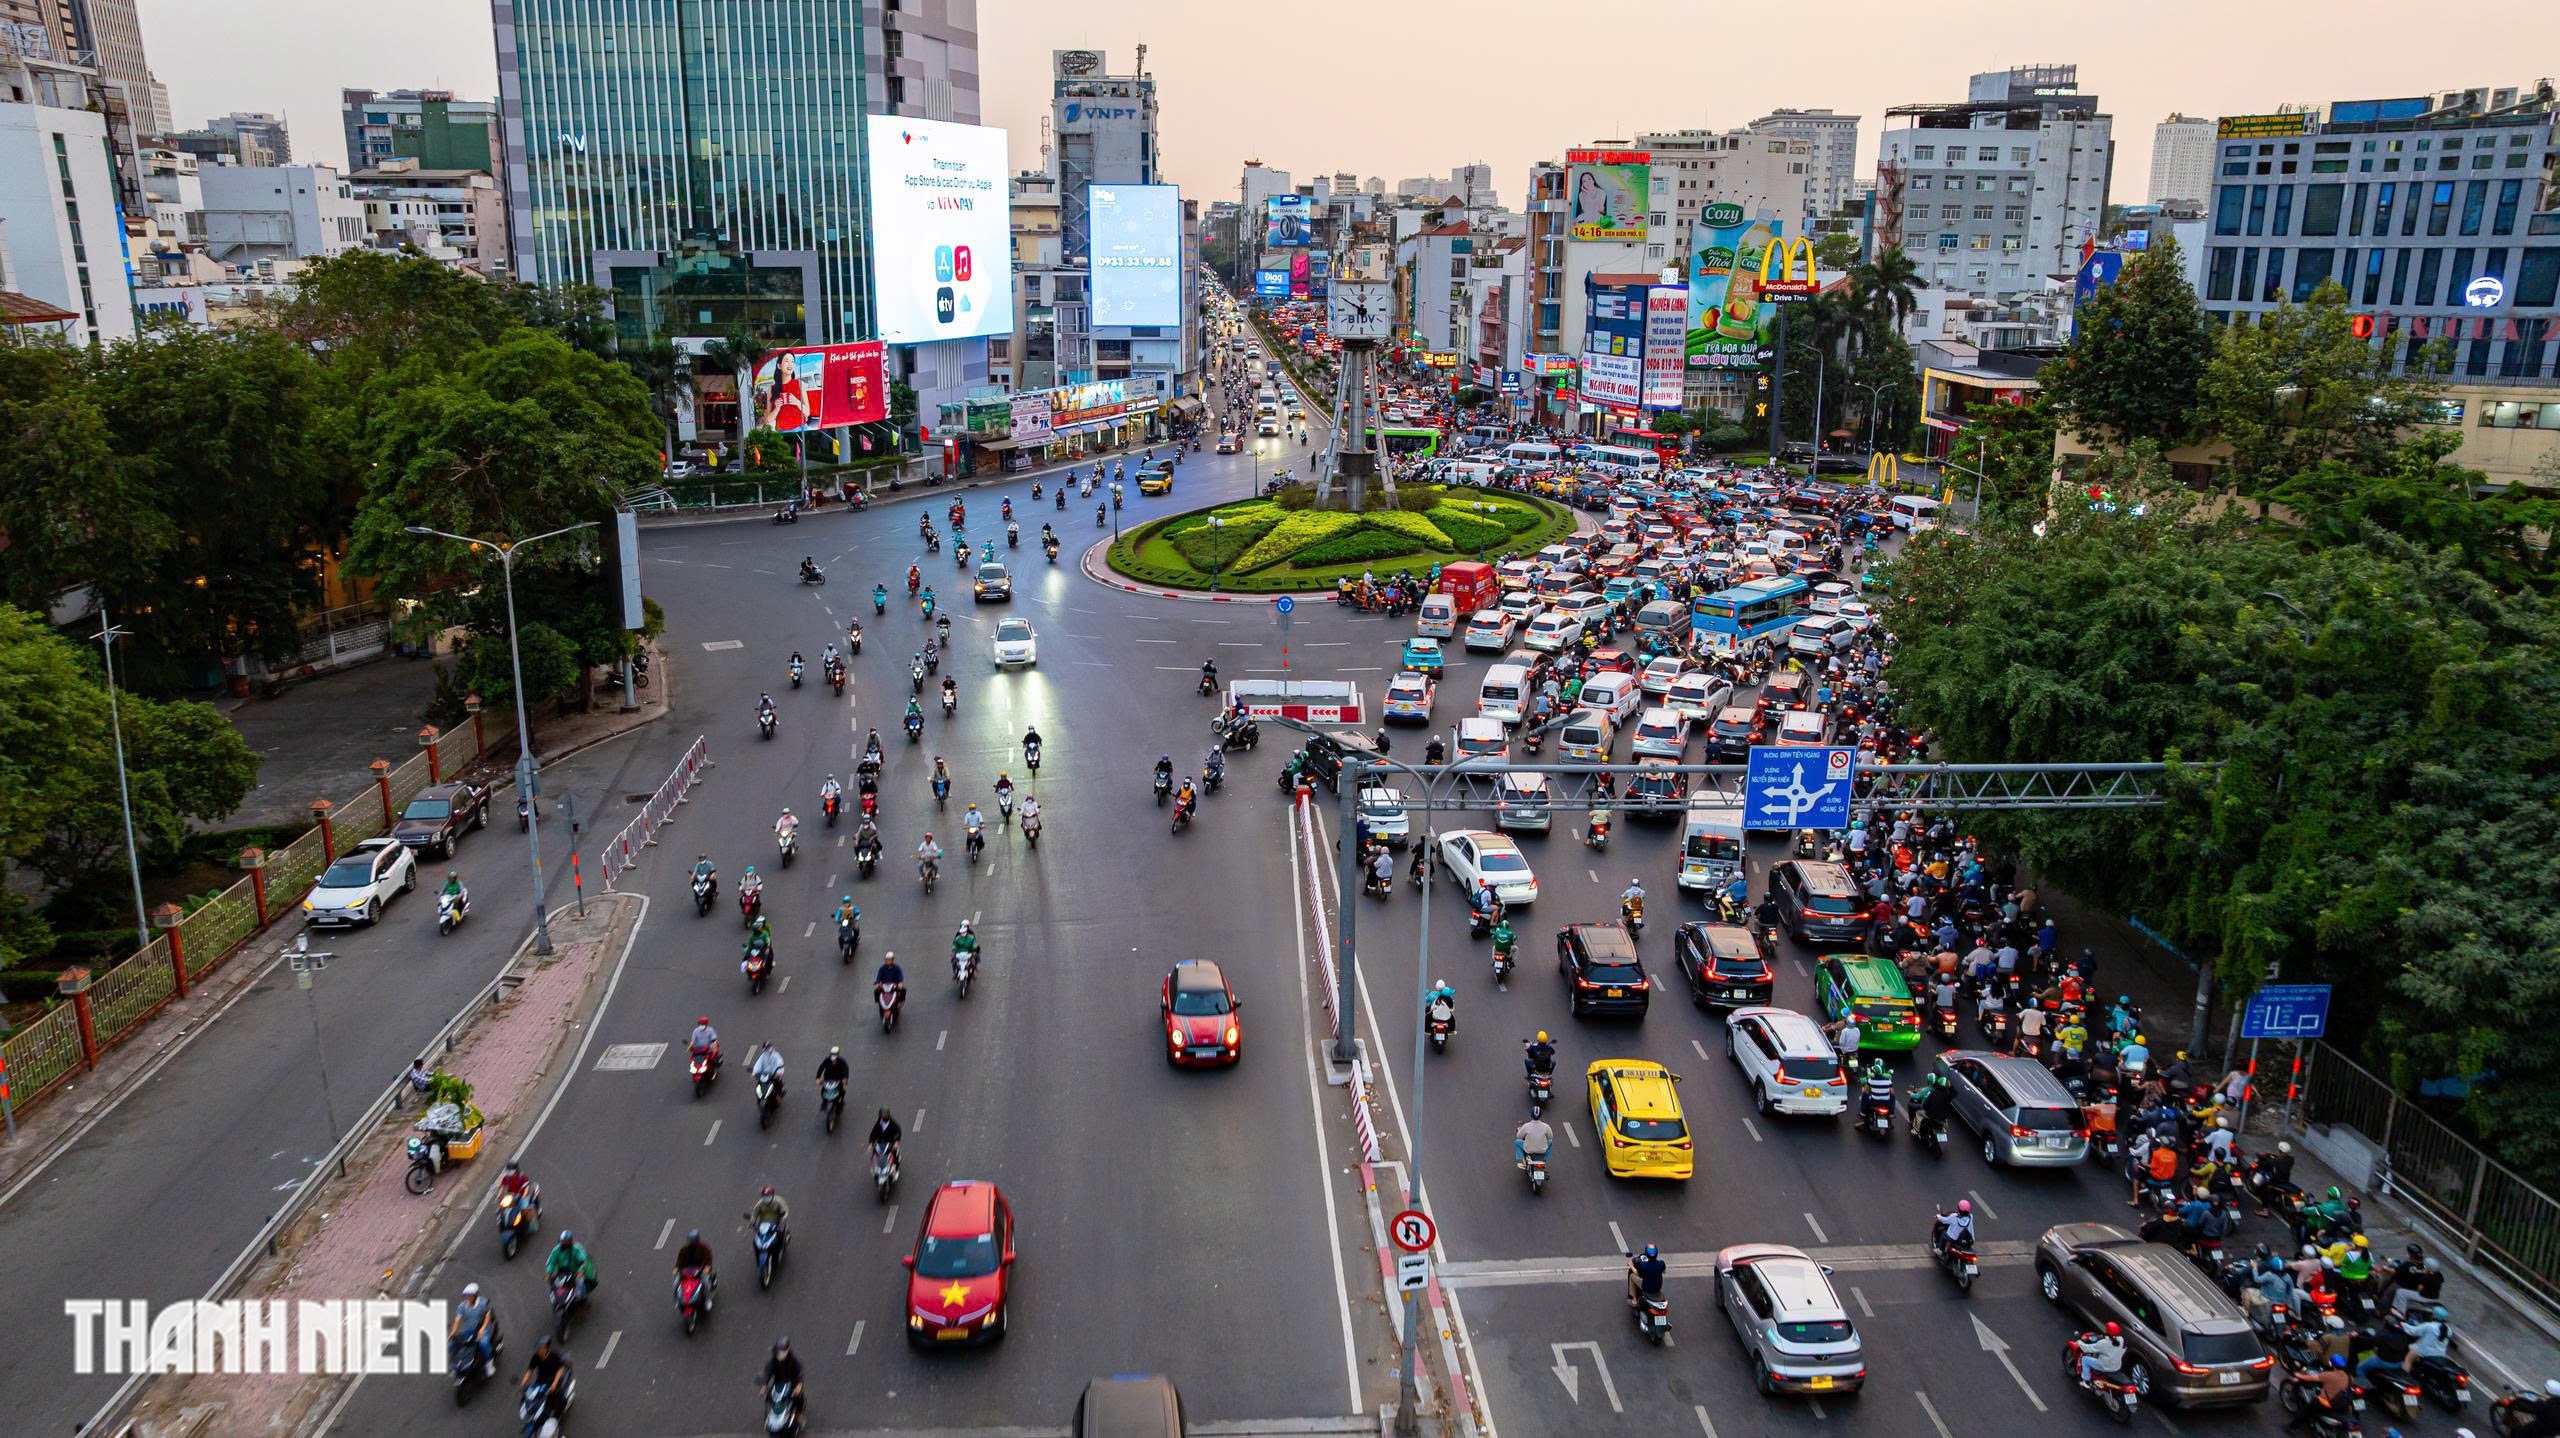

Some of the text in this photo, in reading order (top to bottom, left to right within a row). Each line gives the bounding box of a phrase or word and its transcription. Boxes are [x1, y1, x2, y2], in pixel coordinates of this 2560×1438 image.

[1085, 108, 1136, 119] VNPT
[933, 158, 952, 169] Thanh
[905, 174, 918, 187] App
[919, 175, 935, 186] Store
[936, 176, 942, 187] &
[976, 179, 992, 190] Apple
[1705, 207, 1740, 223] Cozy
[1574, 227, 1602, 237] 14-16
[1708, 256, 1731, 267] Mới
[1766, 283, 1807, 291] McDonald's
[945, 298, 952, 311] tv
[1348, 315, 1375, 324] BIDV
[1705, 341, 1758, 353] TRÀ HOA QUẢ
[1434, 353, 1447, 361] MẮT
[1690, 354, 1708, 365] NGON
[1618, 383, 1638, 397] GIANG
[1040, 419, 1049, 429] 7K
